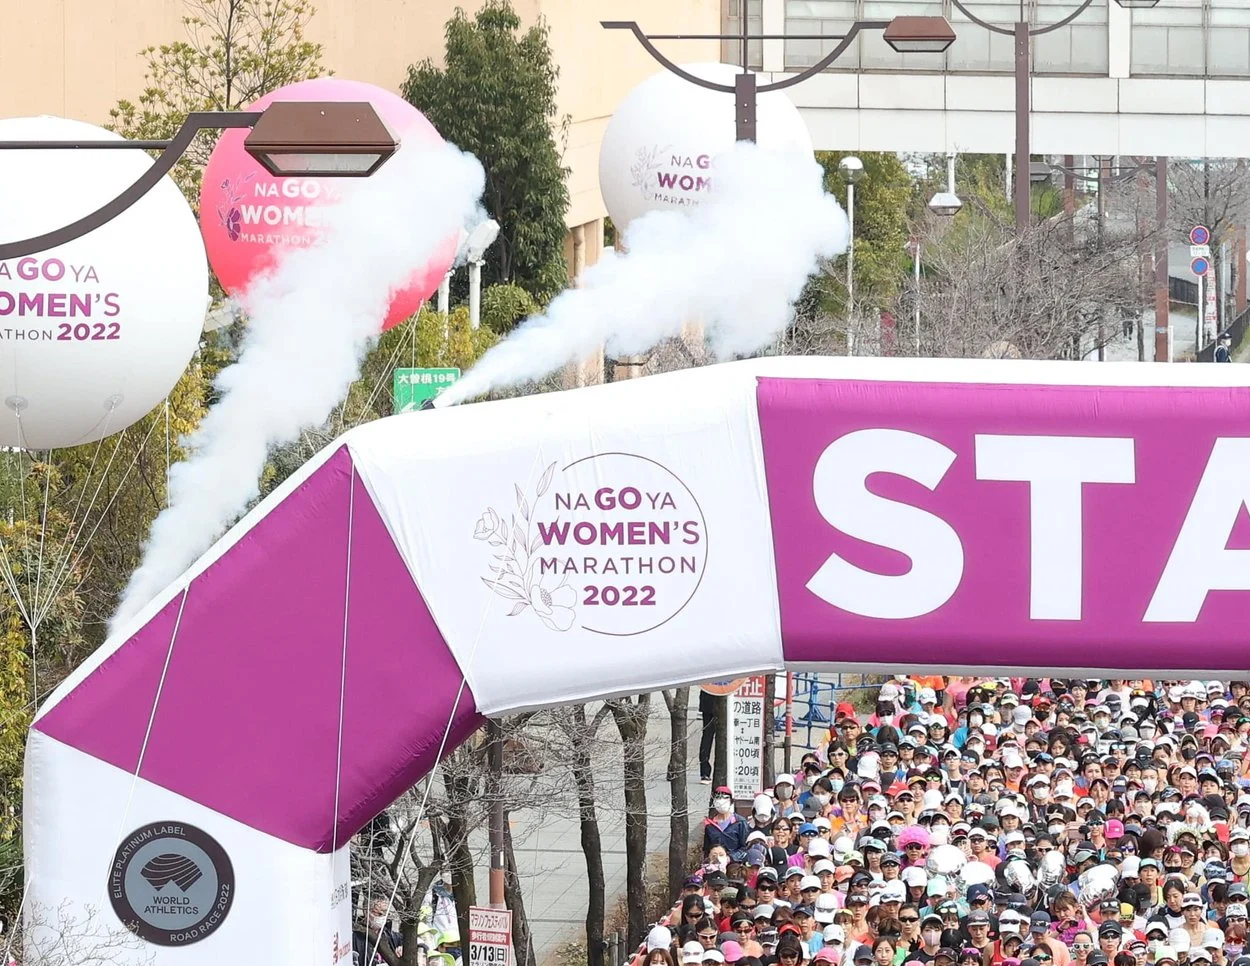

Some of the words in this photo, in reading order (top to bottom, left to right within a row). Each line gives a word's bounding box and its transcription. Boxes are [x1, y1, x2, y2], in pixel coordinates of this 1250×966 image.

[0, 257, 100, 283] AGOYA
[0, 291, 121, 317] OMEN'S
[57, 322, 121, 341] 2022
[554, 486, 677, 511] NAGOYA
[536, 515, 701, 546] WOMEN'S
[540, 556, 697, 574] MARATHON
[582, 585, 657, 606] 2022
[153, 826, 187, 836] LABEL
[116, 829, 153, 870] PLATINUM
[113, 871, 123, 899] ELITE
[144, 905, 199, 915] ATHLETICS
[152, 896, 191, 905] WORLD
[169, 928, 199, 942] ROAD
[198, 910, 221, 934] RACE
[217, 883, 230, 911] 2022
